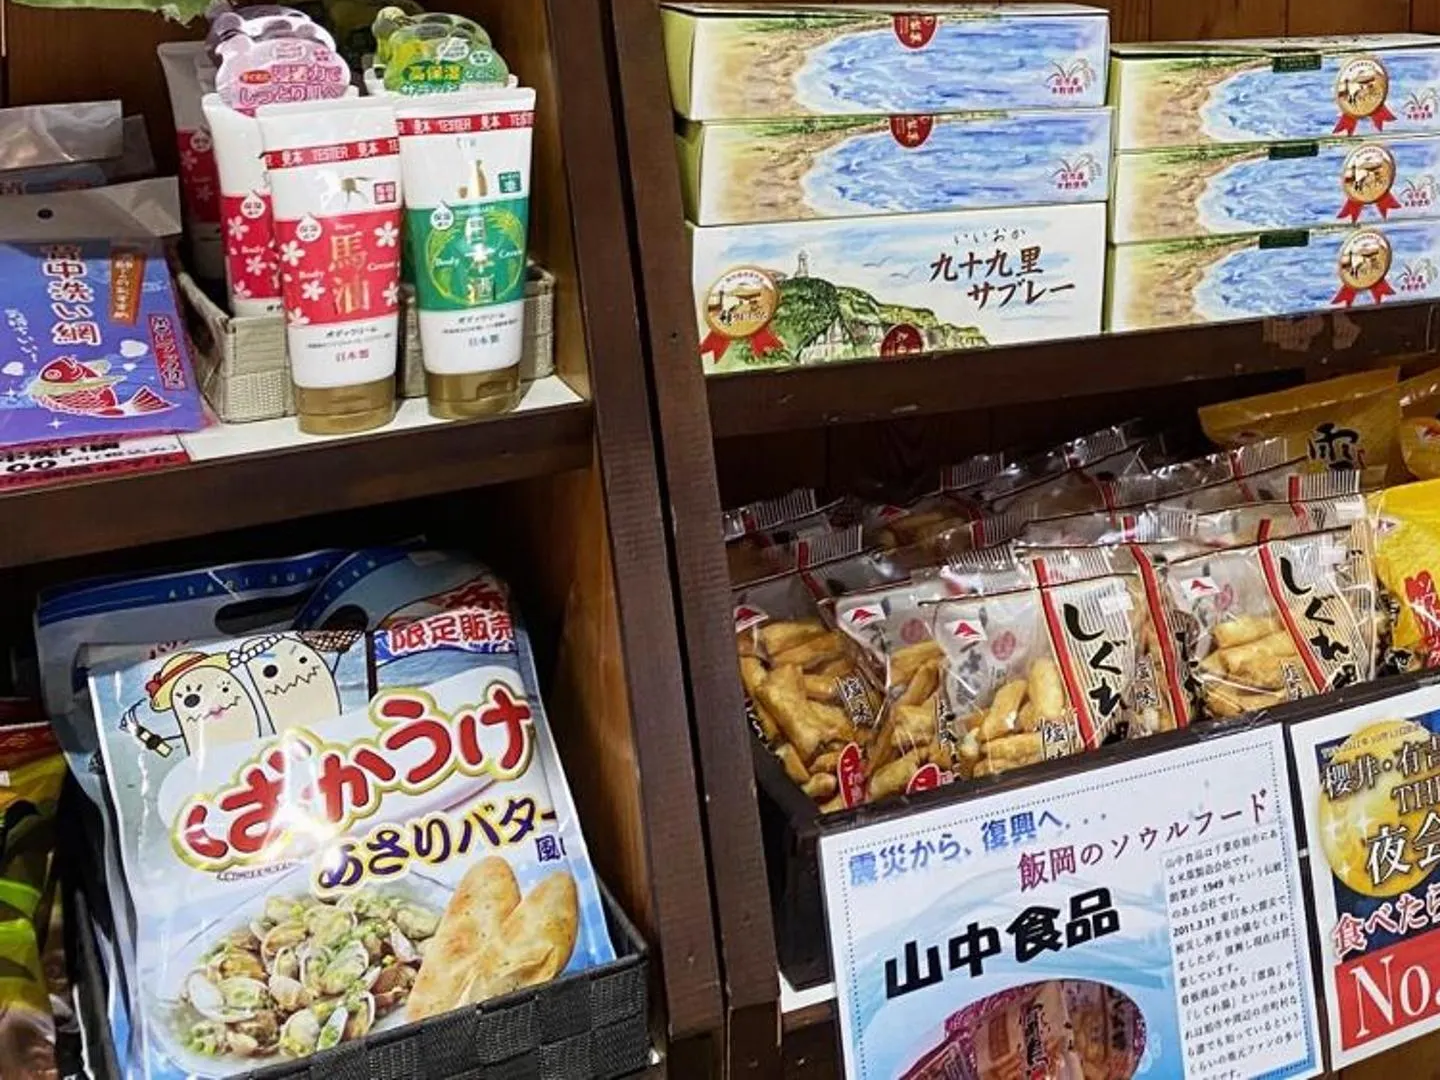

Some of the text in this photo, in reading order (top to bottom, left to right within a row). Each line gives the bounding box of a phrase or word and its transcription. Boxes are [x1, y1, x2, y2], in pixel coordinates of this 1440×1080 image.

[312, 147, 348, 162] TESTER
[929, 246, 1044, 283] 九十九里
[953, 227, 1027, 246] いいおか
[330, 230, 371, 315] 馬油
[967, 279, 1077, 312] サブレー
[319, 796, 557, 890] あさりバター
[1016, 787, 1269, 893] 飯岡のソウルフード
[884, 887, 1121, 1001] 山中食品
